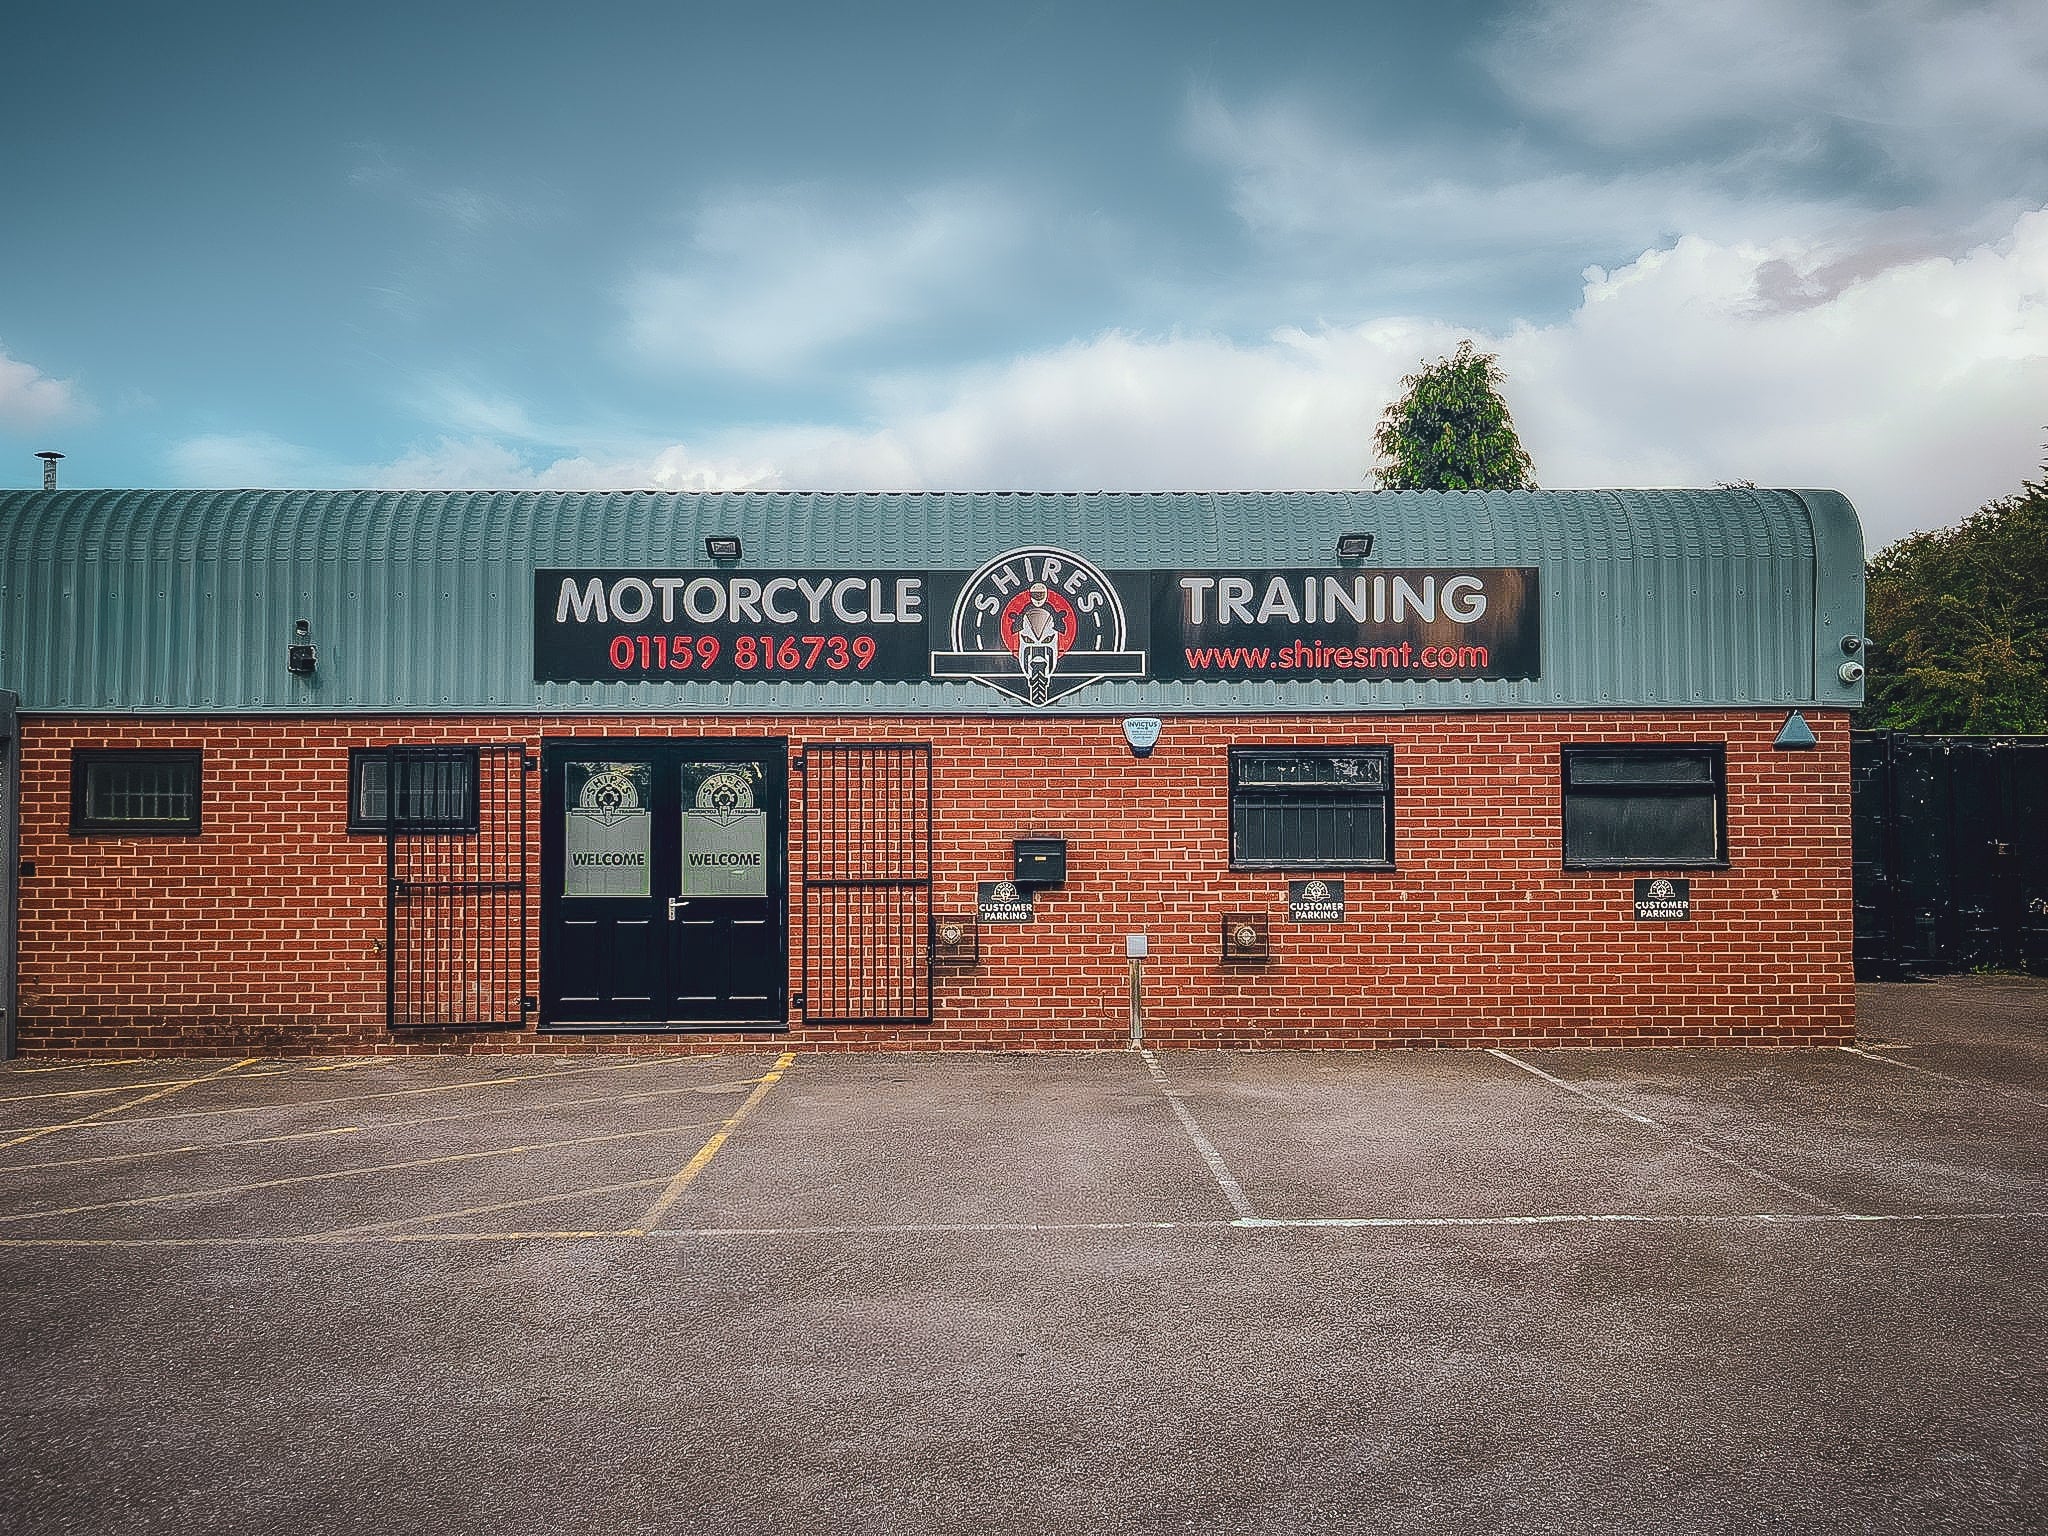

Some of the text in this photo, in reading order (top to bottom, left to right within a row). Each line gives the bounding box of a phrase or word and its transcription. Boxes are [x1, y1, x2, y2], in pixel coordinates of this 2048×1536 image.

[974, 557, 1104, 615] SHIRES
[556, 577, 922, 623] MOTORCYCLE
[1180, 576, 1487, 624] TRAINING
[609, 635, 876, 670] 01159 816739
[1185, 640, 1488, 669] www.shiresmt.com
[572, 852, 645, 866] WELCOME
[688, 852, 761, 866] WELCOME
[979, 903, 1032, 912] CUSTOMER
[1289, 902, 1344, 911] CUSTOMER
[1635, 901, 1689, 909] CUSTOMER
[984, 912, 1027, 920] PARKING
[1295, 911, 1339, 919] PARKING
[1640, 910, 1684, 918] PARKING
